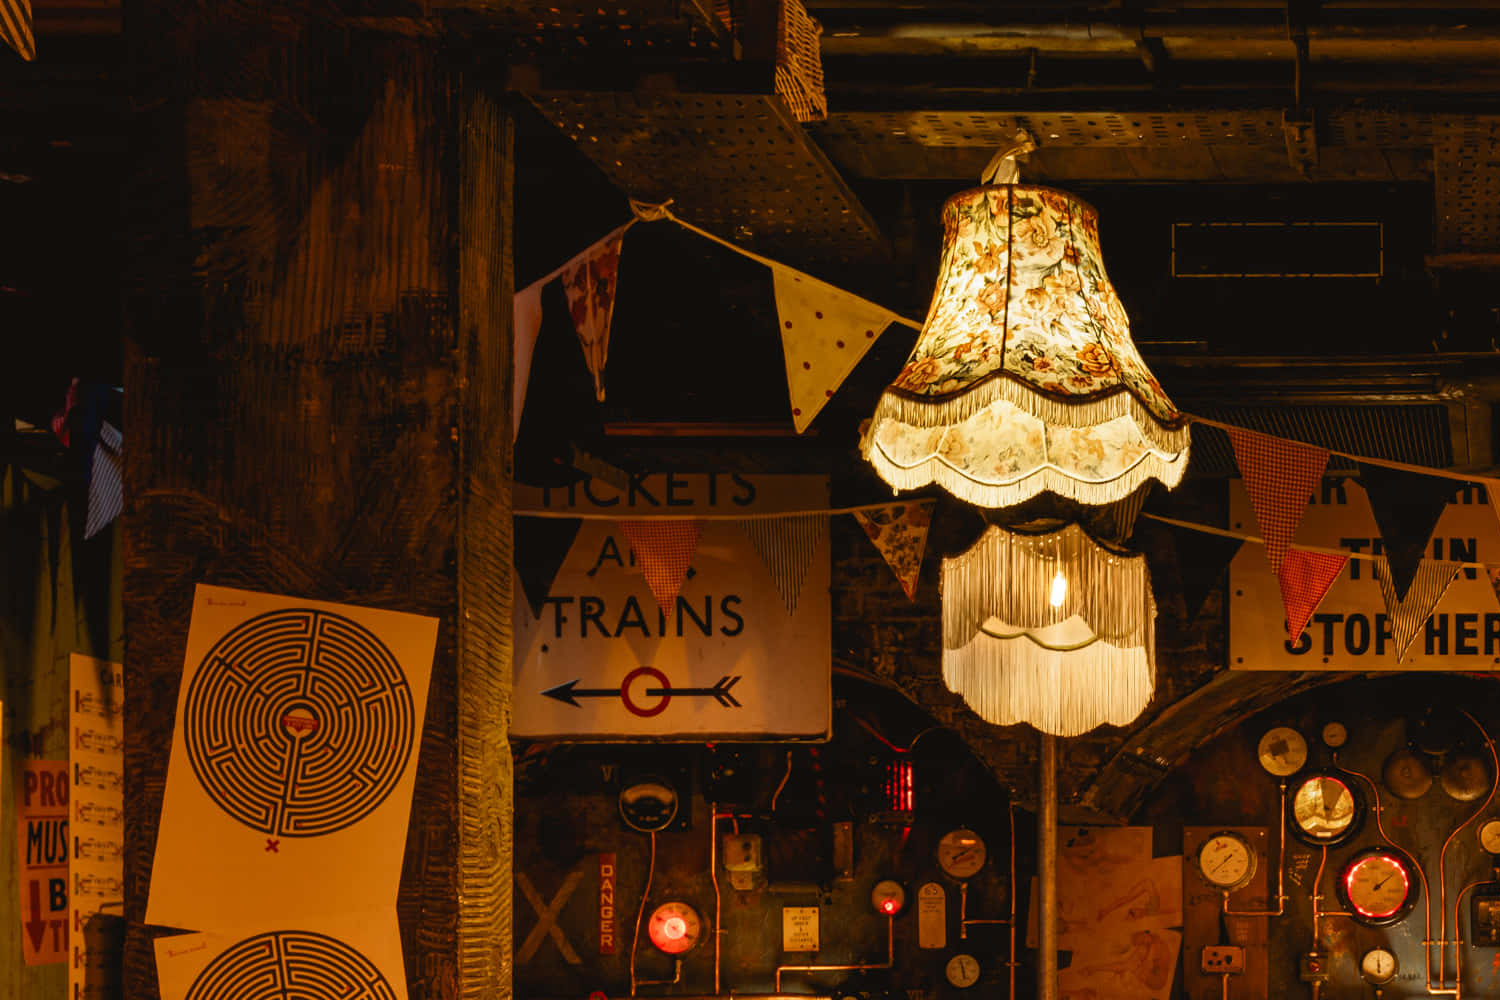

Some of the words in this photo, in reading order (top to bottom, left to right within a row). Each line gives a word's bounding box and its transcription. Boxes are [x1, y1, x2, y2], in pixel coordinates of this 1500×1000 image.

[1341, 538, 1476, 579] TIN
[542, 595, 745, 638] TRAINS
[601, 864, 614, 946] DANGER
